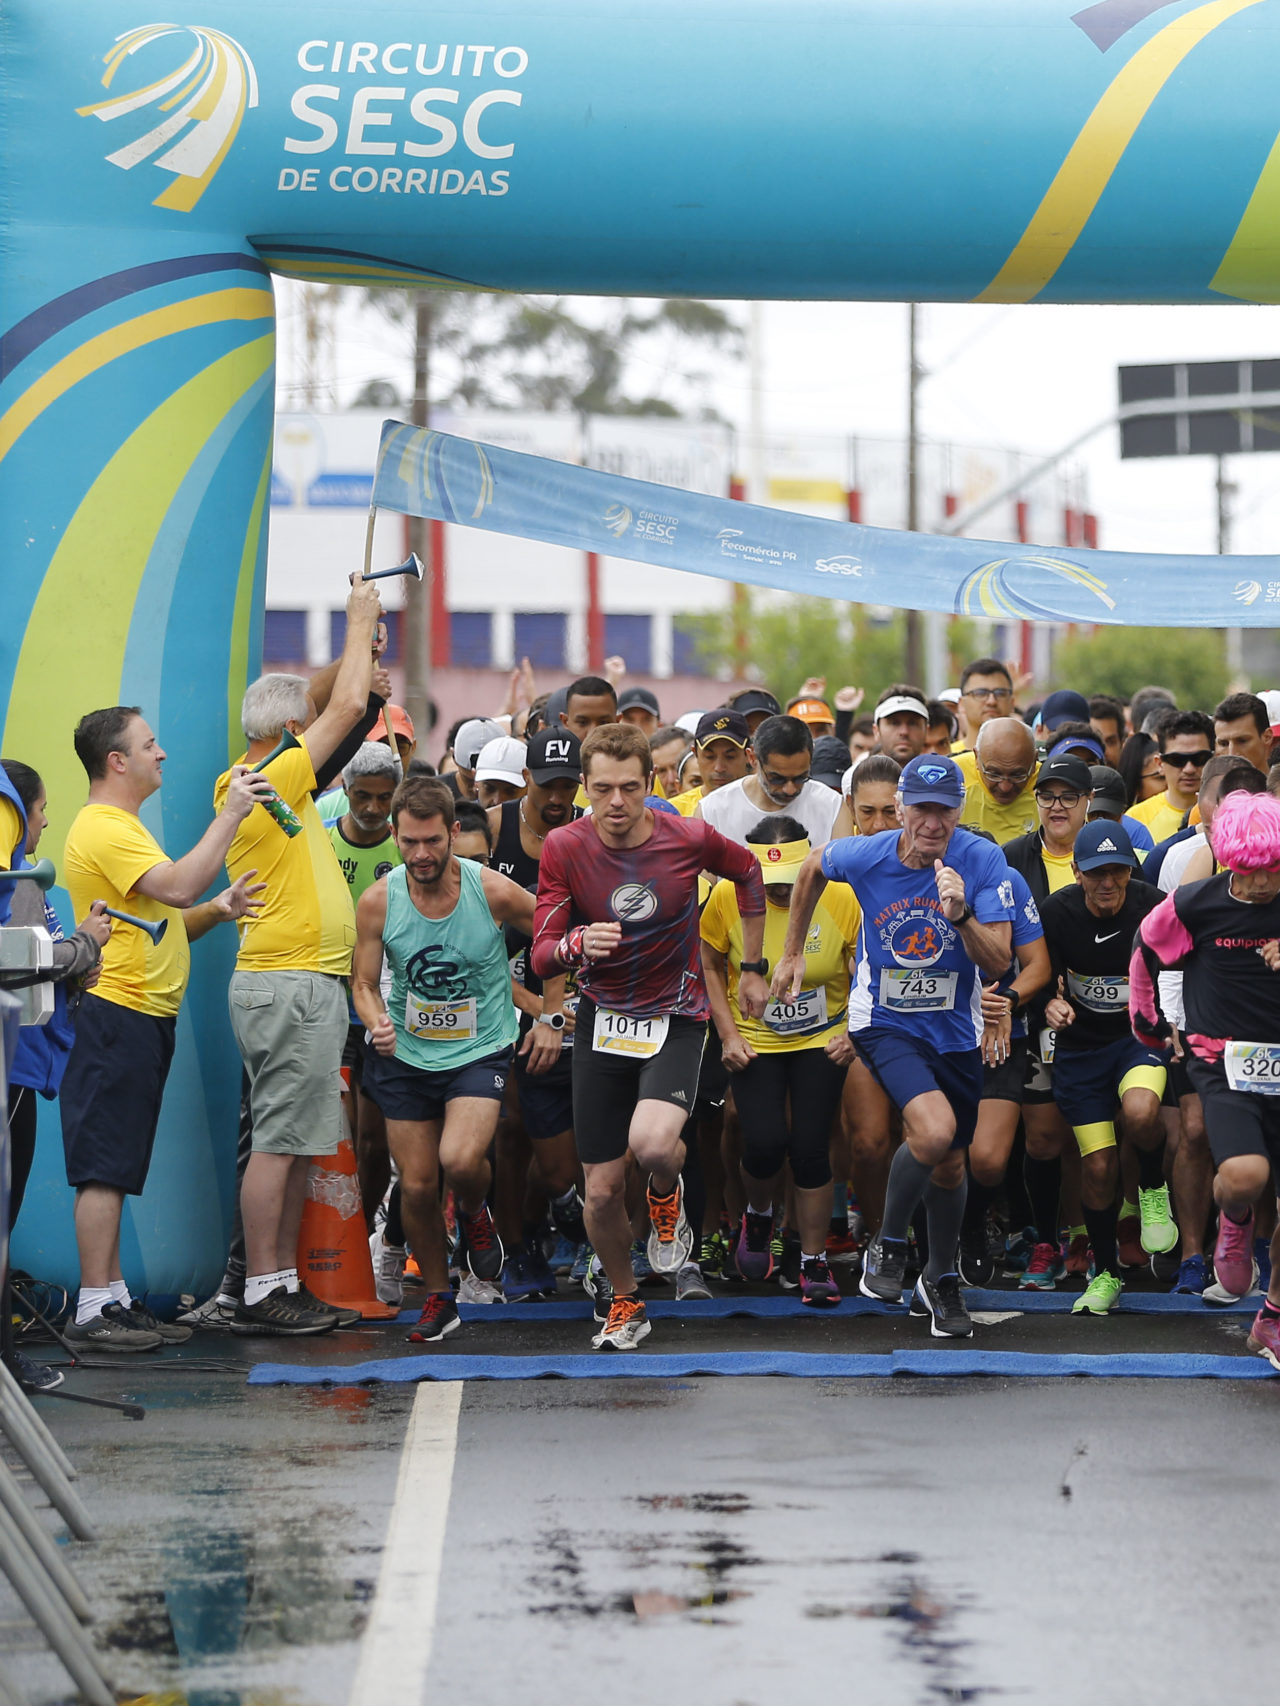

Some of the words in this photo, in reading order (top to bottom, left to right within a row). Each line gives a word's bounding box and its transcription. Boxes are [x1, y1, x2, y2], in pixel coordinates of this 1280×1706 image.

[297, 40, 529, 78] CIRCUITO
[283, 84, 522, 159] SESC
[277, 168, 318, 192] DE
[329, 167, 510, 196] CORRIDAS
[639, 510, 679, 525] CIRCUITO
[635, 520, 677, 539] SESC
[721, 539, 780, 558] Fecomércio
[782, 550, 797, 561] PR
[815, 557, 863, 577] Sesc
[545, 740, 571, 757] FV
[498, 862, 515, 874] FV
[874, 898, 910, 928] MATRIX
[911, 969, 926, 979] 6k
[1091, 976, 1106, 985] 6k
[899, 979, 937, 996] 743
[1081, 983, 1119, 1000] 799
[433, 1005, 452, 1013] 12k
[771, 1001, 809, 1020] 405
[418, 1011, 458, 1027] 959
[604, 1014, 653, 1038] 1011
[1256, 1048, 1272, 1059] 6k
